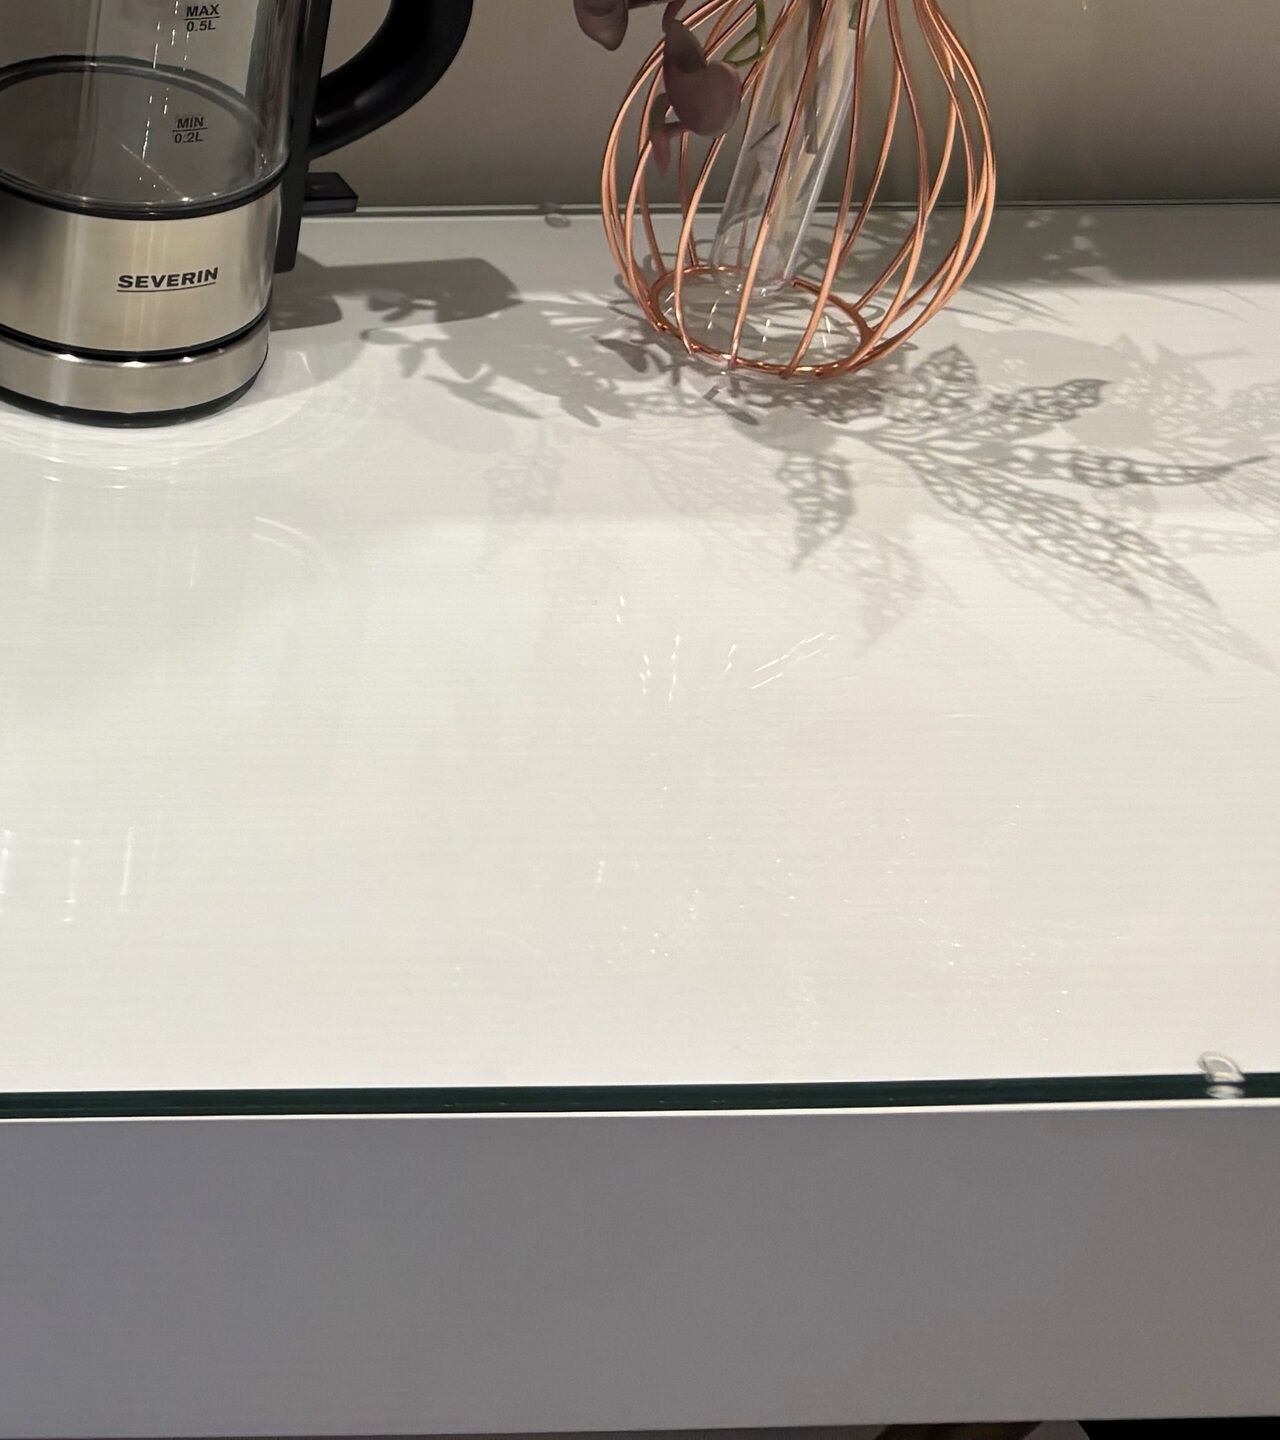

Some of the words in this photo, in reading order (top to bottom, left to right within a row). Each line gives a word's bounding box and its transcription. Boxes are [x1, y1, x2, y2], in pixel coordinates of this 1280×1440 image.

[185, 4, 220, 18] MAX
[186, 19, 216, 32] 0.5L
[176, 116, 205, 130] MIN
[173, 131, 204, 144] 0.2L
[117, 266, 219, 289] SEVERIN
